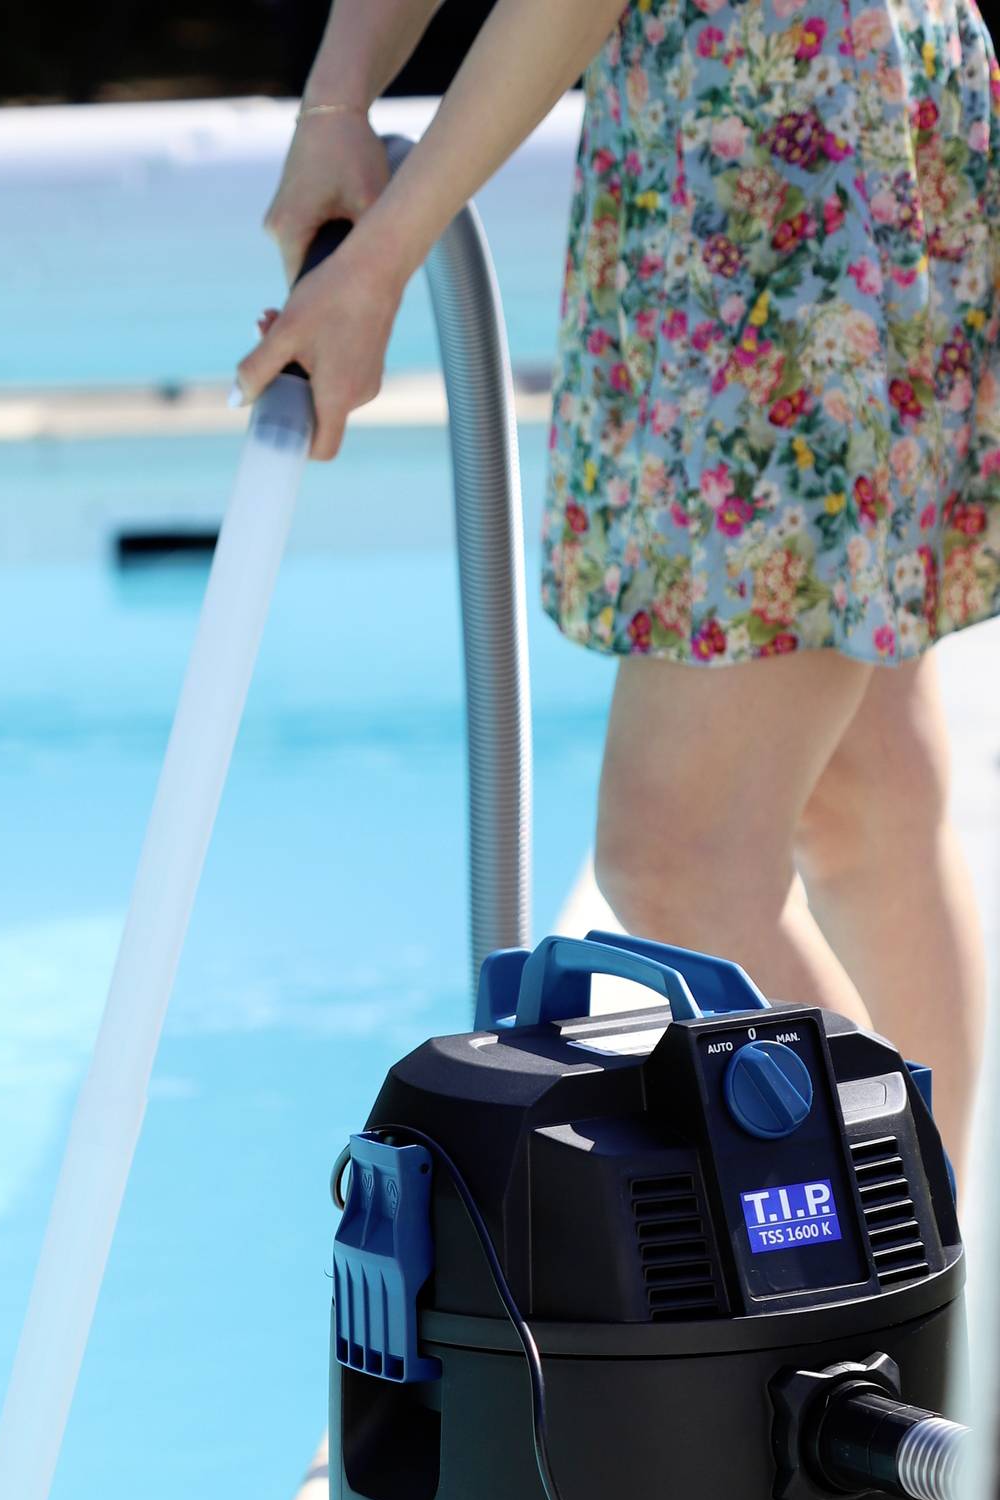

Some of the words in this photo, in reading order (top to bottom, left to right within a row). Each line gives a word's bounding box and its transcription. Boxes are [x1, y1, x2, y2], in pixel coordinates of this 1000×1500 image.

[775, 1032, 801, 1044] MAN.
[707, 1041, 734, 1055] AUTO
[743, 1183, 831, 1224] T.I.P.
[758, 1229, 784, 1246] TSS
[785, 1223, 819, 1242] 1600
[821, 1221, 832, 1236] K
